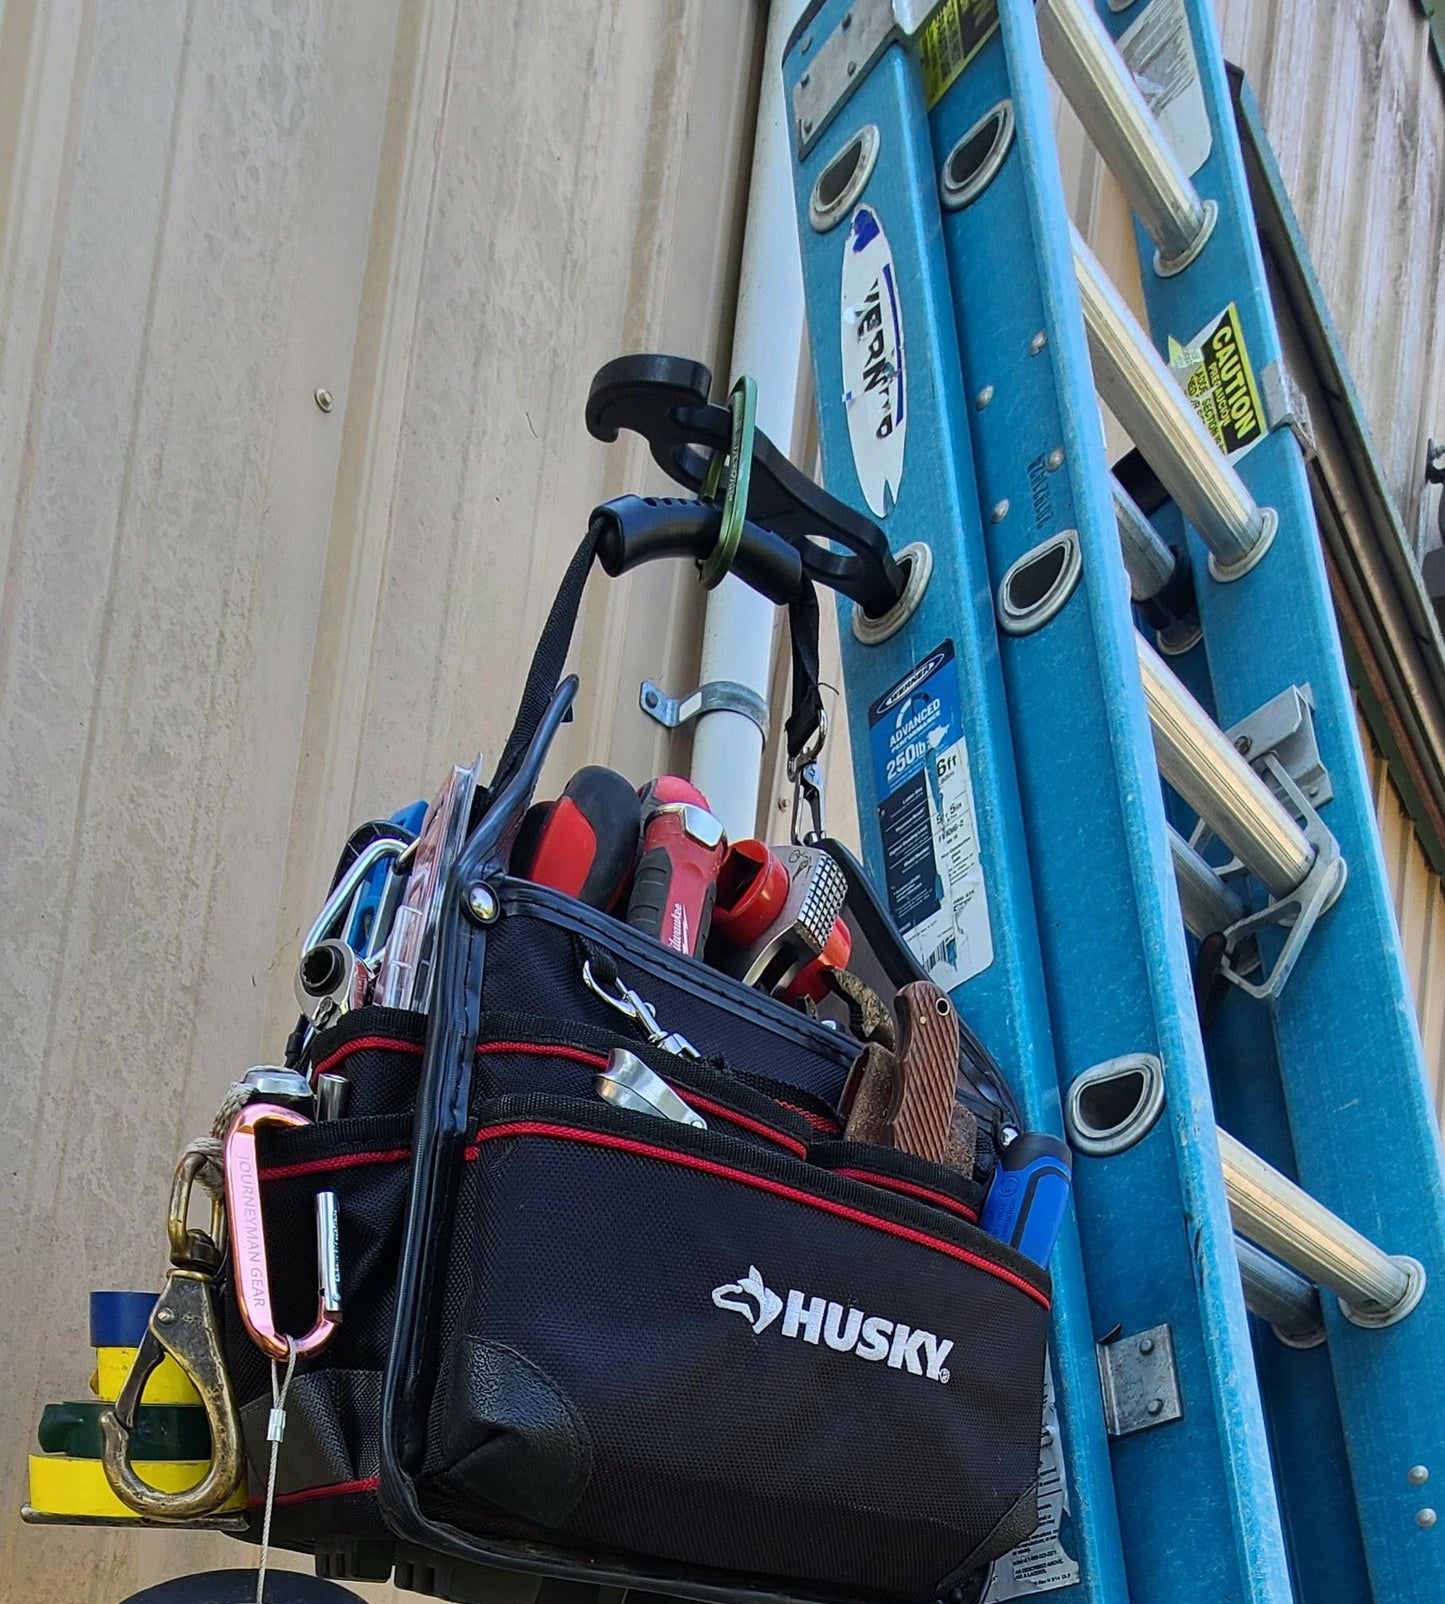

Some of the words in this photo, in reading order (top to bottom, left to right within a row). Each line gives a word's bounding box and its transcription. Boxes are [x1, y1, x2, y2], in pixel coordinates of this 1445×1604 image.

[1212, 325, 1257, 440] CAUTION
[889, 698, 941, 748] ADVANCED
[886, 742, 926, 781] 250lb
[667, 903, 682, 952] ilwaukee
[236, 1154, 260, 1262] JOURNEYMAN
[250, 1267, 265, 1307] GEAR
[781, 1289, 954, 1381] HUSKY
